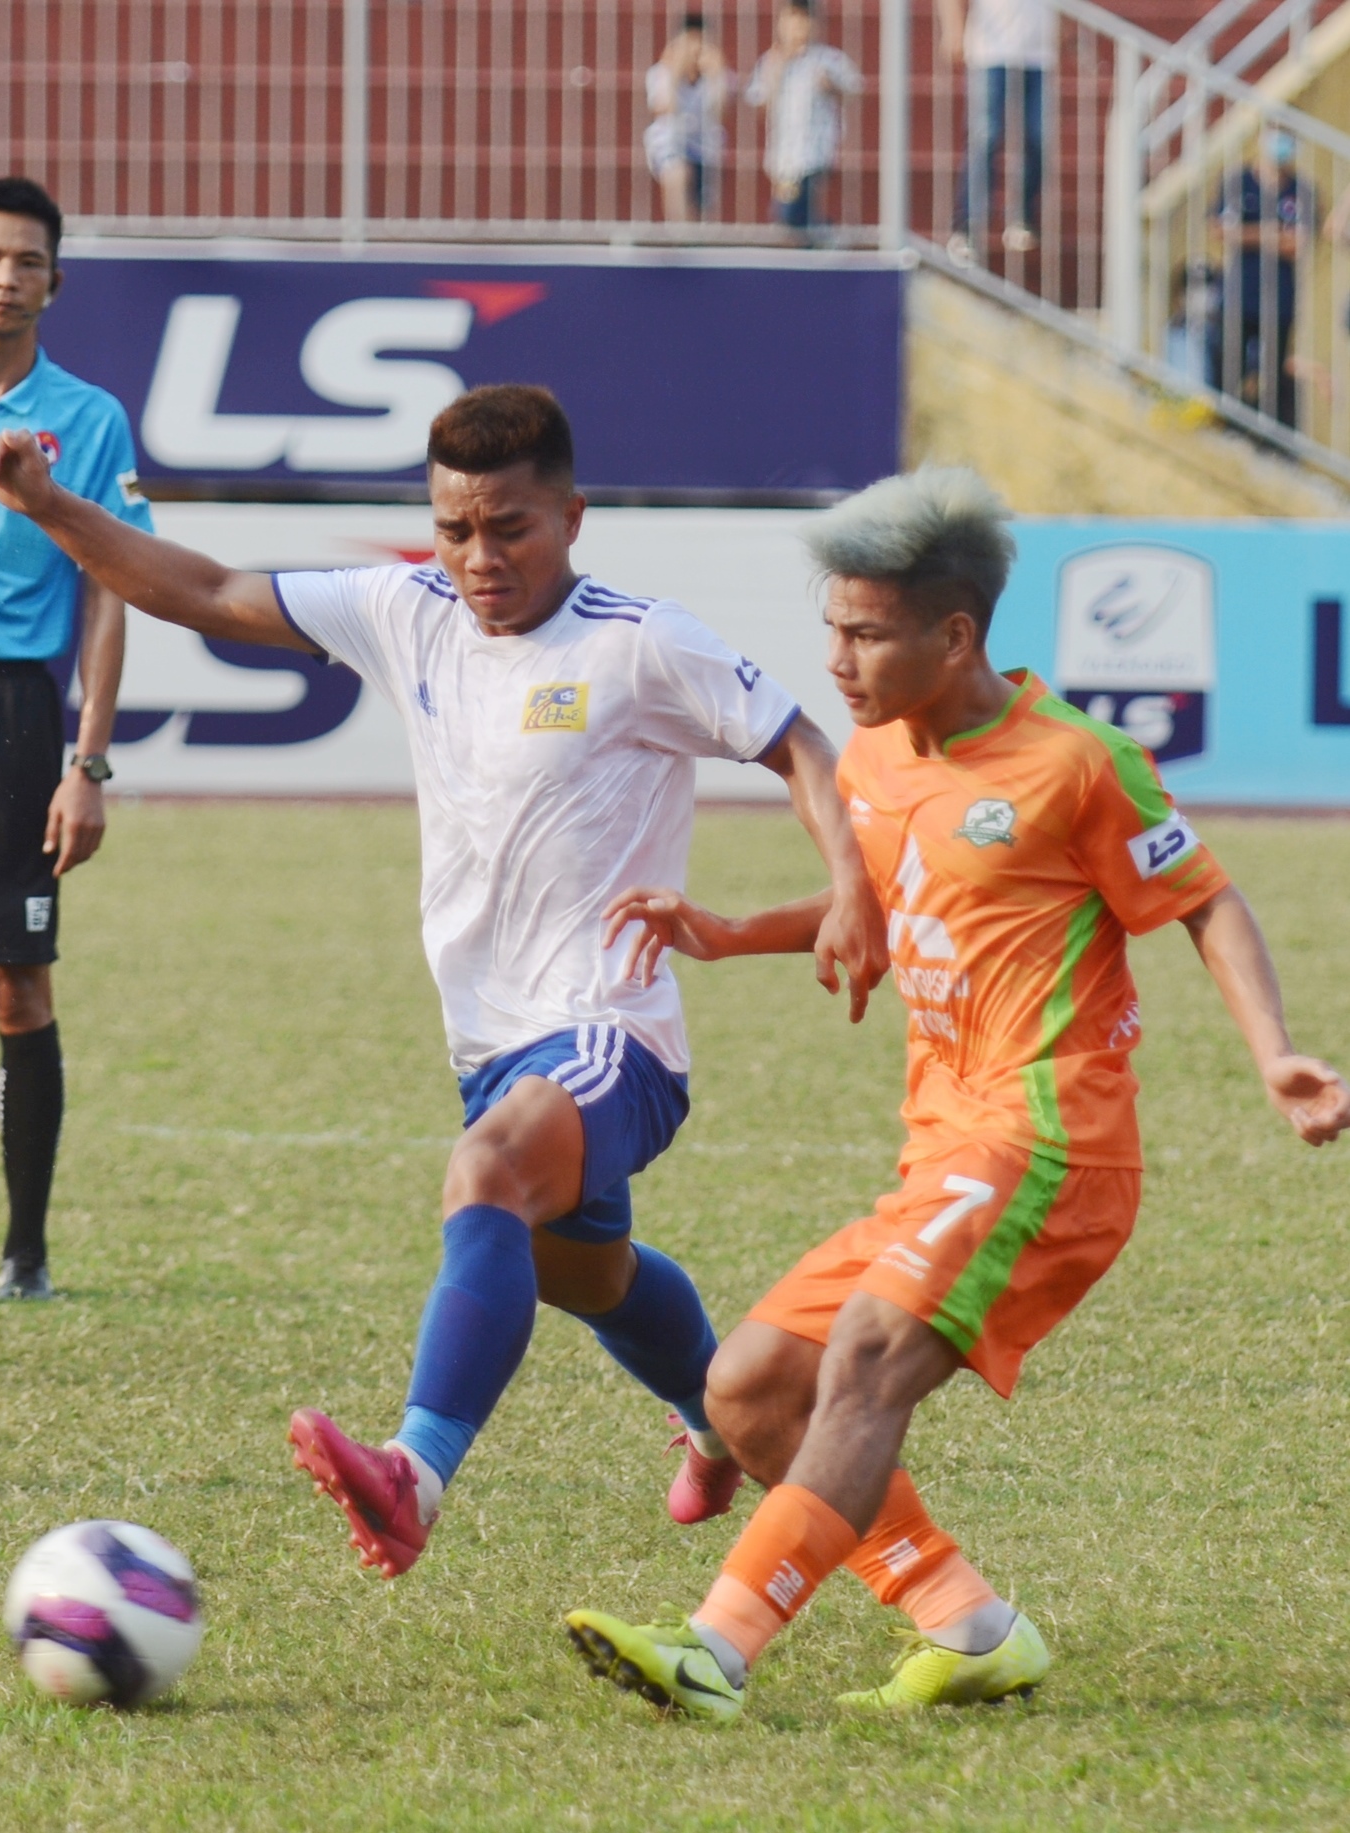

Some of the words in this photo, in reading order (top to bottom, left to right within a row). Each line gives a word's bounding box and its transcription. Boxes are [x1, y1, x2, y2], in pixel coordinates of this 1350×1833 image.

[140, 293, 476, 471] LS
[1146, 828, 1187, 869] LS
[915, 1173, 997, 1247] 7
